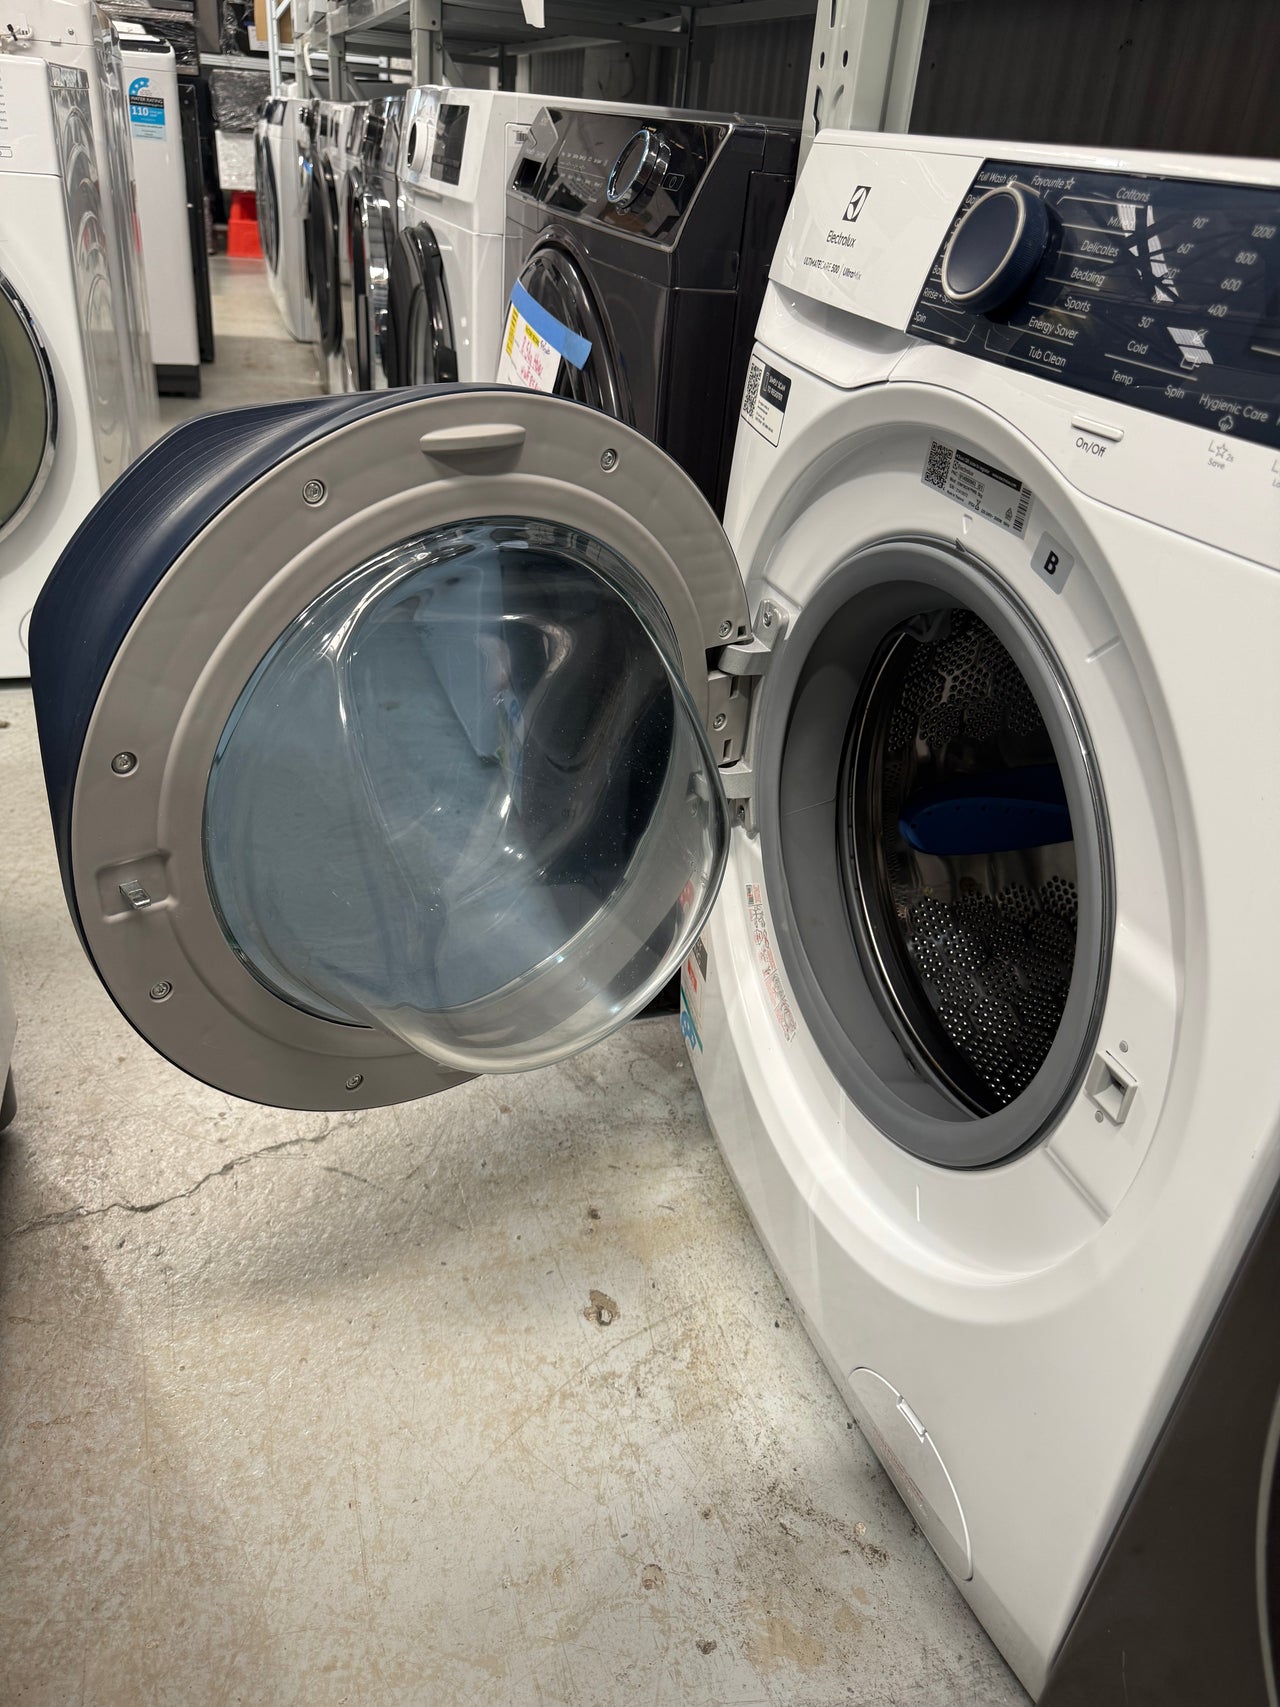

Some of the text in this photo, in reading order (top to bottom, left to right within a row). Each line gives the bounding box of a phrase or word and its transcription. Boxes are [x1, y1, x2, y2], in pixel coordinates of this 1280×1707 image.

[131, 106, 149, 116] 110
[977, 171, 989, 181] Full
[989, 173, 1007, 184] Wash
[1031, 175, 1065, 189] Favourite
[1116, 187, 1150, 202] Cottons
[826, 230, 857, 248] Electrolux
[1251, 224, 1276, 240] 1200
[1081, 240, 1119, 257] Delicates
[1235, 251, 1258, 265] 800
[1070, 267, 1106, 286] Bedding
[1220, 278, 1242, 292] 600
[922, 287, 939, 300] Rinse
[1064, 296, 1092, 312] Sports
[1207, 304, 1228, 317] 400
[913, 310, 927, 323] Spin
[1028, 316, 1079, 339] Energy Saver
[1127, 340, 1149, 355] Cold
[1028, 345, 1067, 367] Tub Clean
[1111, 369, 1134, 386] Temp
[1164, 384, 1185, 399] Spin
[1199, 393, 1242, 415] Hygienic
[1242, 405, 1269, 422] Care
[1075, 437, 1106, 458] On/Off
[1207, 458, 1226, 470] Save
[1043, 550, 1060, 576] B
